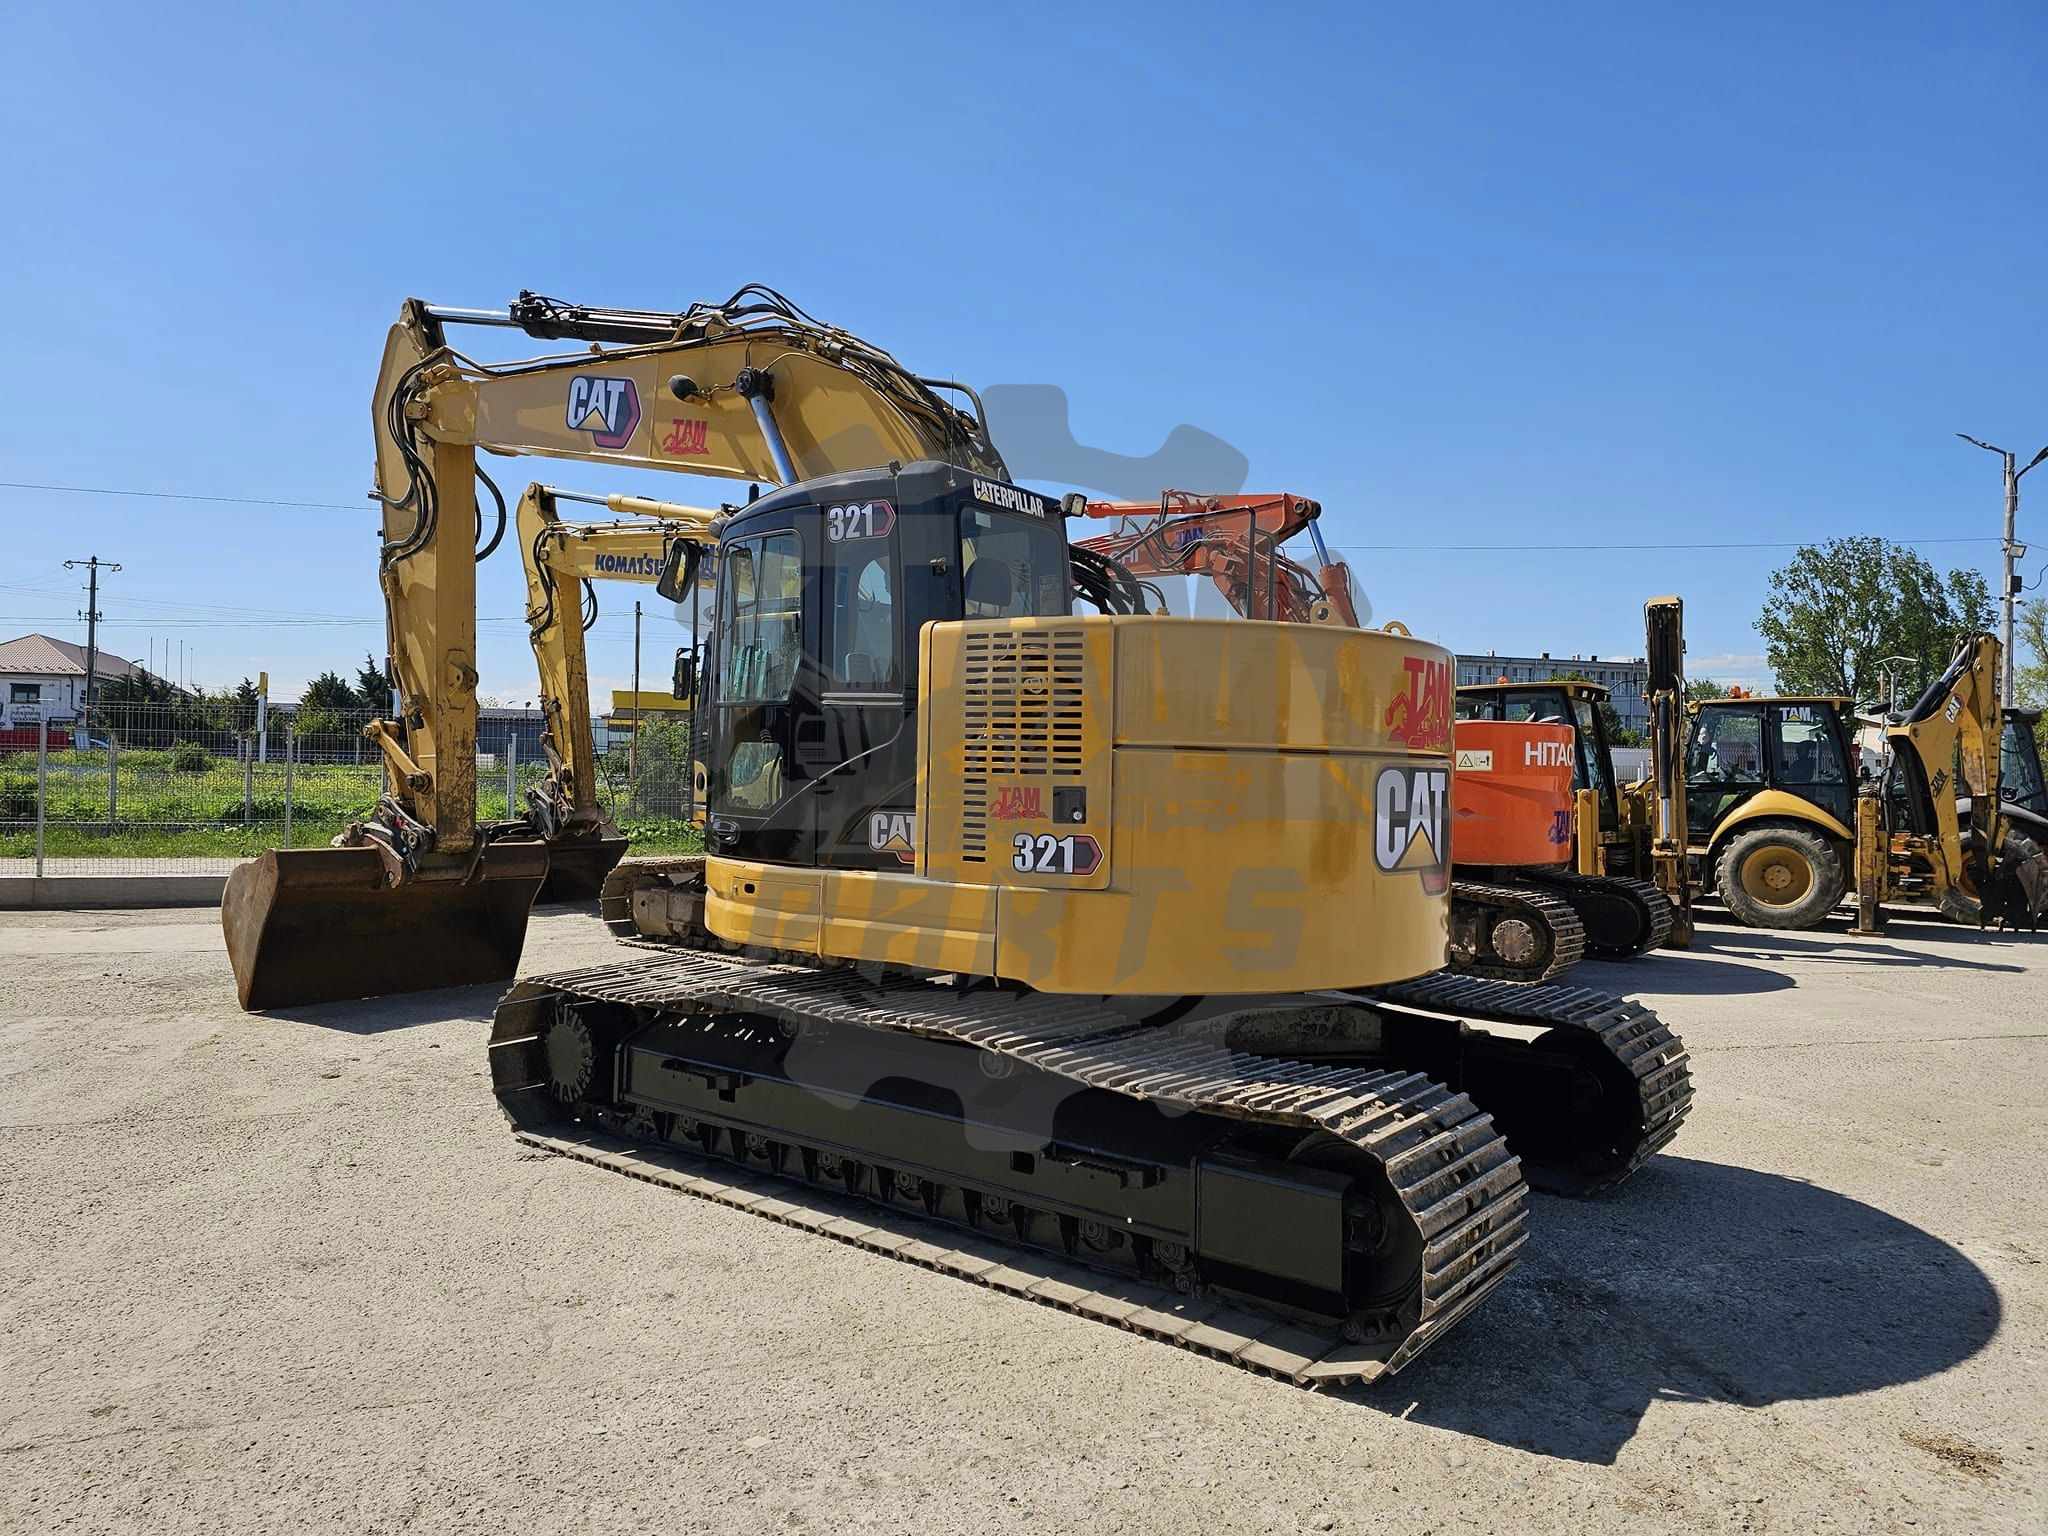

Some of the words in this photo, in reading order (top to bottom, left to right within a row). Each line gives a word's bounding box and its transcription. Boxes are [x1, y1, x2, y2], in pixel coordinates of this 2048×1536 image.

[567, 376, 627, 433] CAT
[972, 478, 1045, 519] CATERPILLAR
[828, 502, 874, 542] 321
[1779, 706, 1813, 722] TAM
[999, 785, 1042, 816] TAM
[1376, 769, 1447, 870] CAT
[1013, 834, 1075, 874] 321
